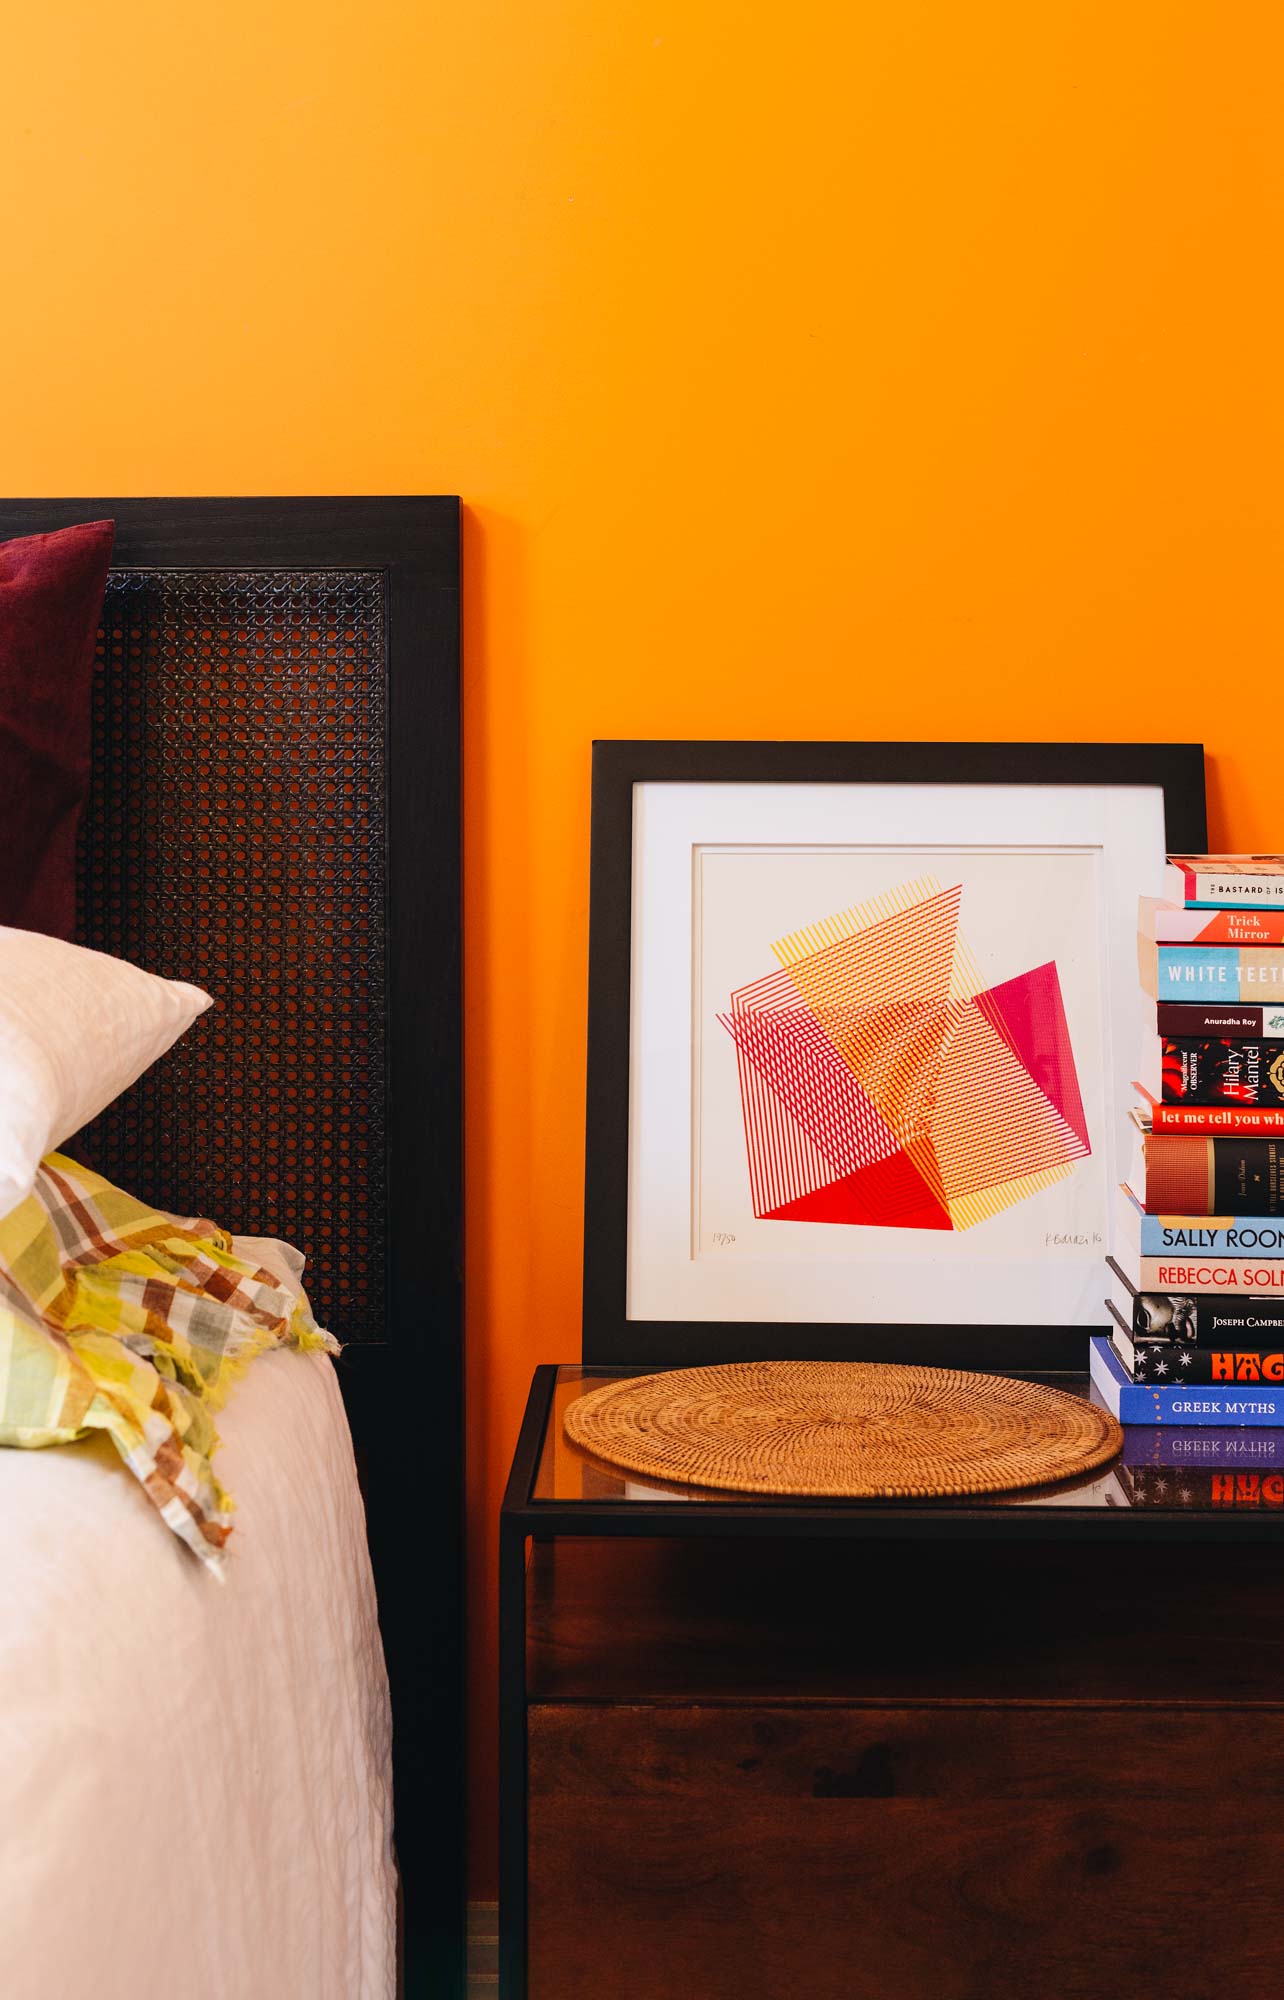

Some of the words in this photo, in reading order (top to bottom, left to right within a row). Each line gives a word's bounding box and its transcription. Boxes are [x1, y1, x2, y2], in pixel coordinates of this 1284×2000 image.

[1218, 886, 1263, 894] BASTARD
[1227, 915, 1261, 926] Trick
[1227, 928, 1270, 939] Mirror
[1168, 966, 1227, 982] WHITE
[1235, 967, 1284, 983] TEET
[1242, 1018, 1257, 1027] Roy
[1190, 1052, 1198, 1091] OBSERVER
[1223, 1049, 1243, 1095] Hilary
[1242, 1046, 1259, 1100] Mantel
[1162, 1111, 1180, 1123] let
[1184, 1114, 1205, 1123] me
[1208, 1112, 1232, 1124] tell
[1235, 1115, 1260, 1127] you
[1162, 1228, 1219, 1247] SALLY
[1158, 1266, 1238, 1286] REBECCA
[1243, 1269, 1284, 1287] SOL
[1246, 1317, 1284, 1327] CAMPBE
[1172, 1401, 1221, 1413] GREEK
[1225, 1403, 1276, 1414] MYTHS
